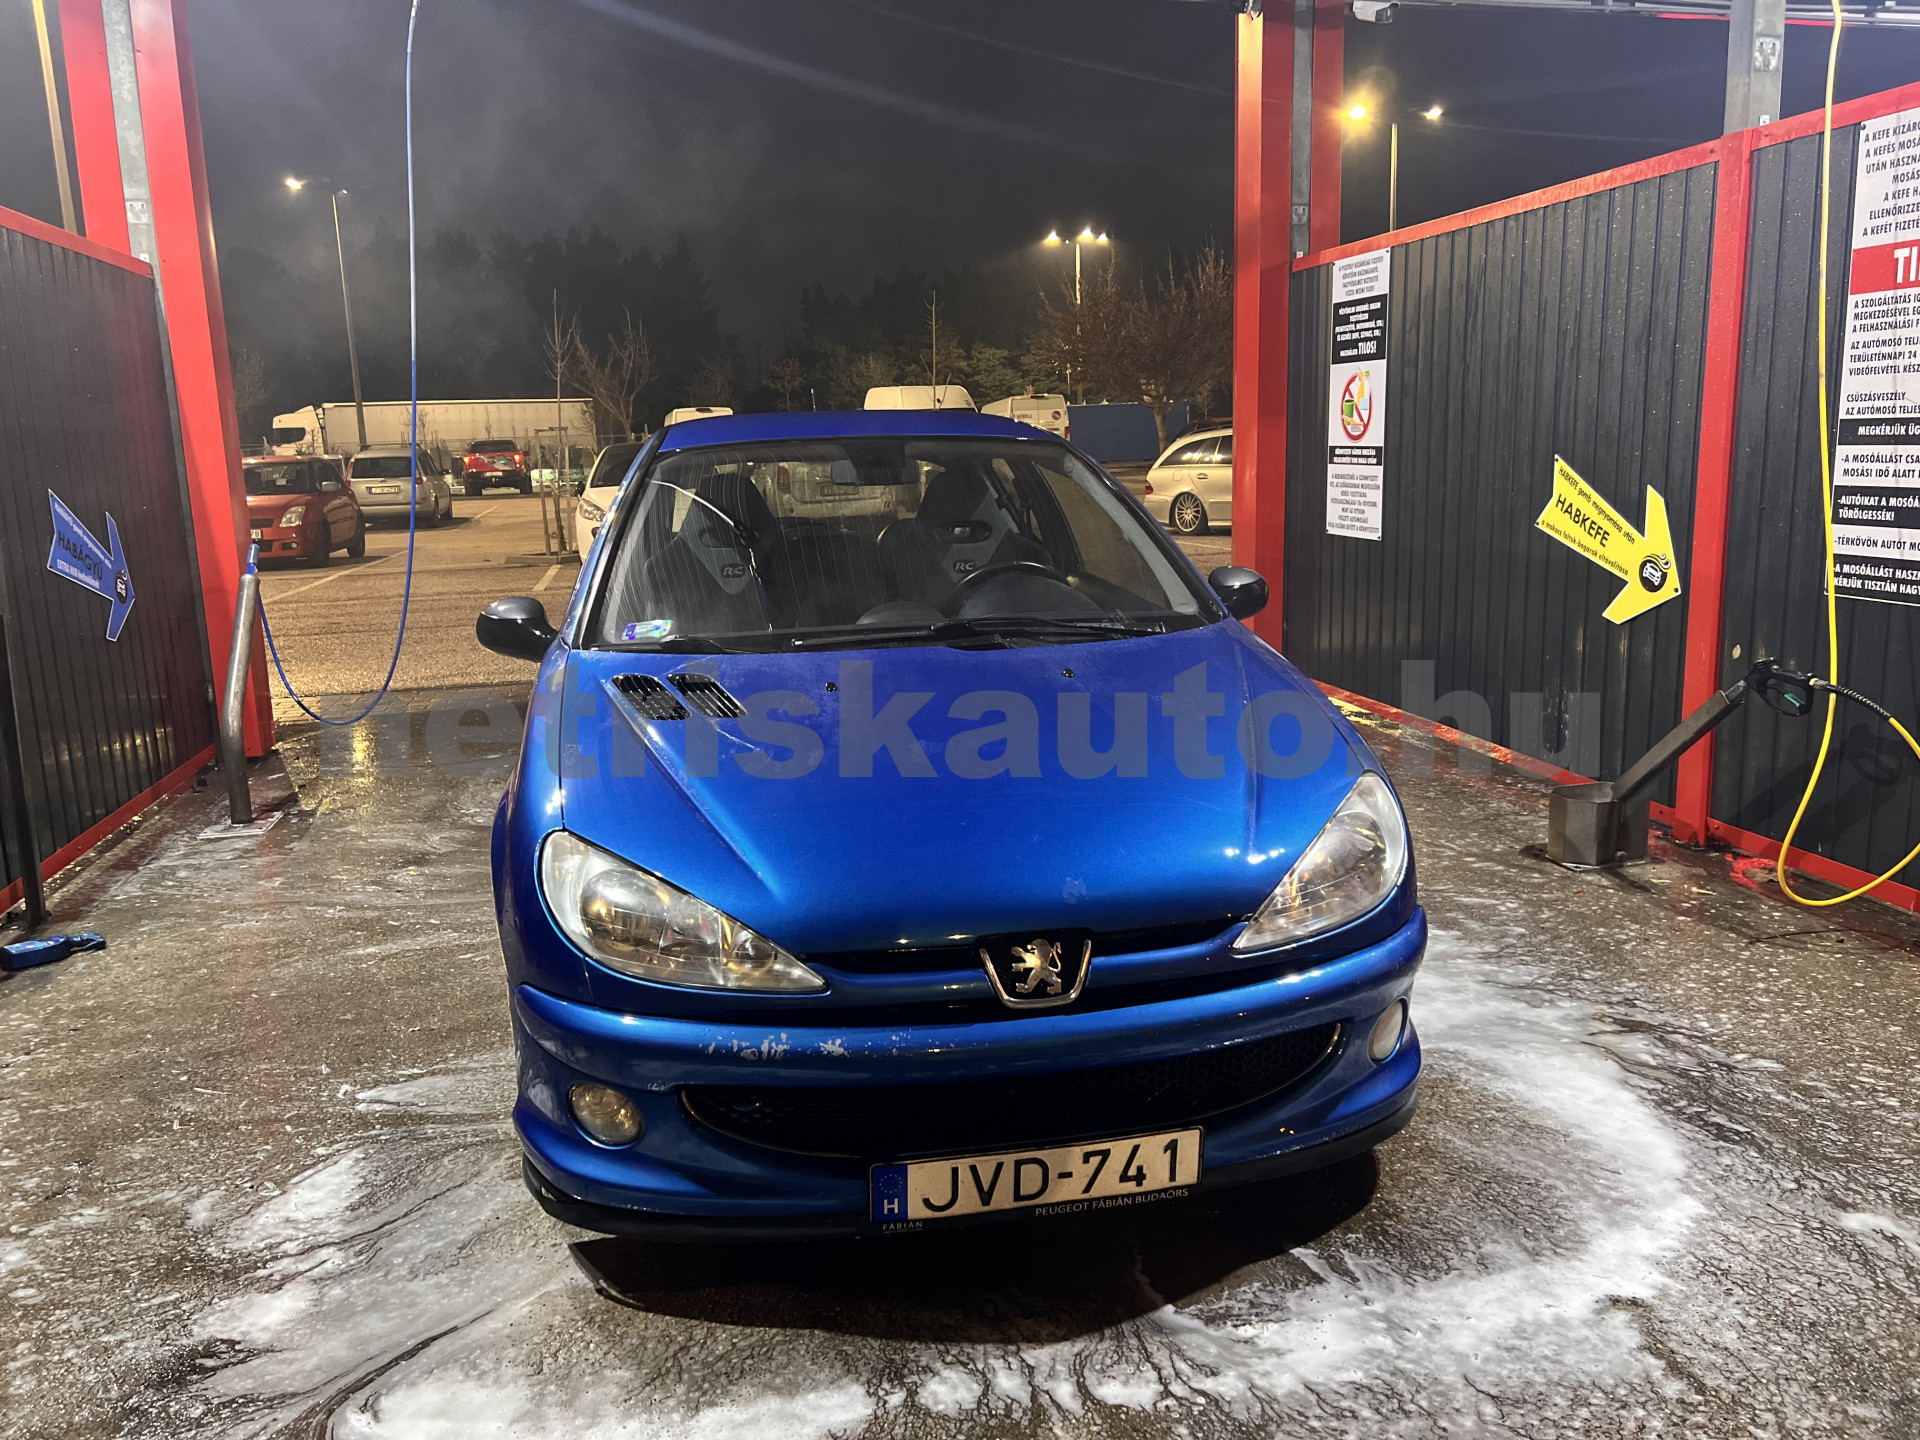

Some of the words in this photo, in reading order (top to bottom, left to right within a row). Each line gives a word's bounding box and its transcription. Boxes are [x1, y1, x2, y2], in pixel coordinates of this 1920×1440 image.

[1864, 133, 1870, 143] A
[1872, 128, 1890, 141] KEFE
[1865, 148, 1871, 158] A
[1873, 141, 1895, 157] KEFÉS
[1866, 160, 1887, 174] UTÁN
[1883, 192, 1889, 202] A
[1892, 188, 1910, 200] KEFE
[1863, 227, 1868, 237] A
[1870, 221, 1892, 235] KEFÉT
[1893, 246, 1920, 284] TI
[1854, 300, 1859, 309] A
[1861, 292, 1911, 308] SZOLGÁLTATÁS
[1853, 306, 1910, 321] MEGKEZDÉSÉVEL
[1852, 325, 1857, 333] A
[1859, 317, 1913, 332] FELHASZNÁLÁSI
[1358, 340, 1377, 355] TILOS!
[1850, 341, 1860, 350] AZ
[1862, 335, 1902, 349] AUTÓMOSÓ
[1907, 350, 1917, 360] 24
[1849, 363, 1900, 376] VIDEÓFELVÉTEL
[1846, 389, 1906, 402] CSÚSZÁSVESZÉLY
[1845, 406, 1855, 415] AZ
[1857, 403, 1896, 415] AUTÓMOSÓ
[1858, 423, 1906, 436] MEGKÉRJÜK
[1841, 454, 1849, 463] -A
[1852, 452, 1903, 463] MOSÓÁLLÁST
[1842, 466, 1872, 477] MOSÁSI
[1875, 466, 1890, 478] IDŐ
[1892, 469, 1915, 478] ALATT
[1558, 466, 1579, 490] HABKEFE
[1577, 487, 1592, 503] gomb
[1837, 494, 1879, 506] -AUTÓIKAT
[1880, 496, 1887, 506] A
[1555, 493, 1610, 548] HABKEFE
[1834, 534, 1878, 548] -TÉRKÖVÖN
[1880, 538, 1906, 550] AUTÓT
[723, 566, 744, 576] RC
[955, 562, 975, 571] RC
[1843, 563, 1894, 578] MOSÓÁLLÁST
[1834, 575, 1862, 589] KÉRJÜK
[1864, 580, 1898, 593] TISZTÁN
[883, 1198, 899, 1215] H
[922, 1138, 1180, 1213] JVD-741
[1035, 1201, 1090, 1217] PEUGEOT
[1092, 1196, 1133, 1210] FÁBIÁN
[1135, 1188, 1190, 1204] BUDAÖRS
